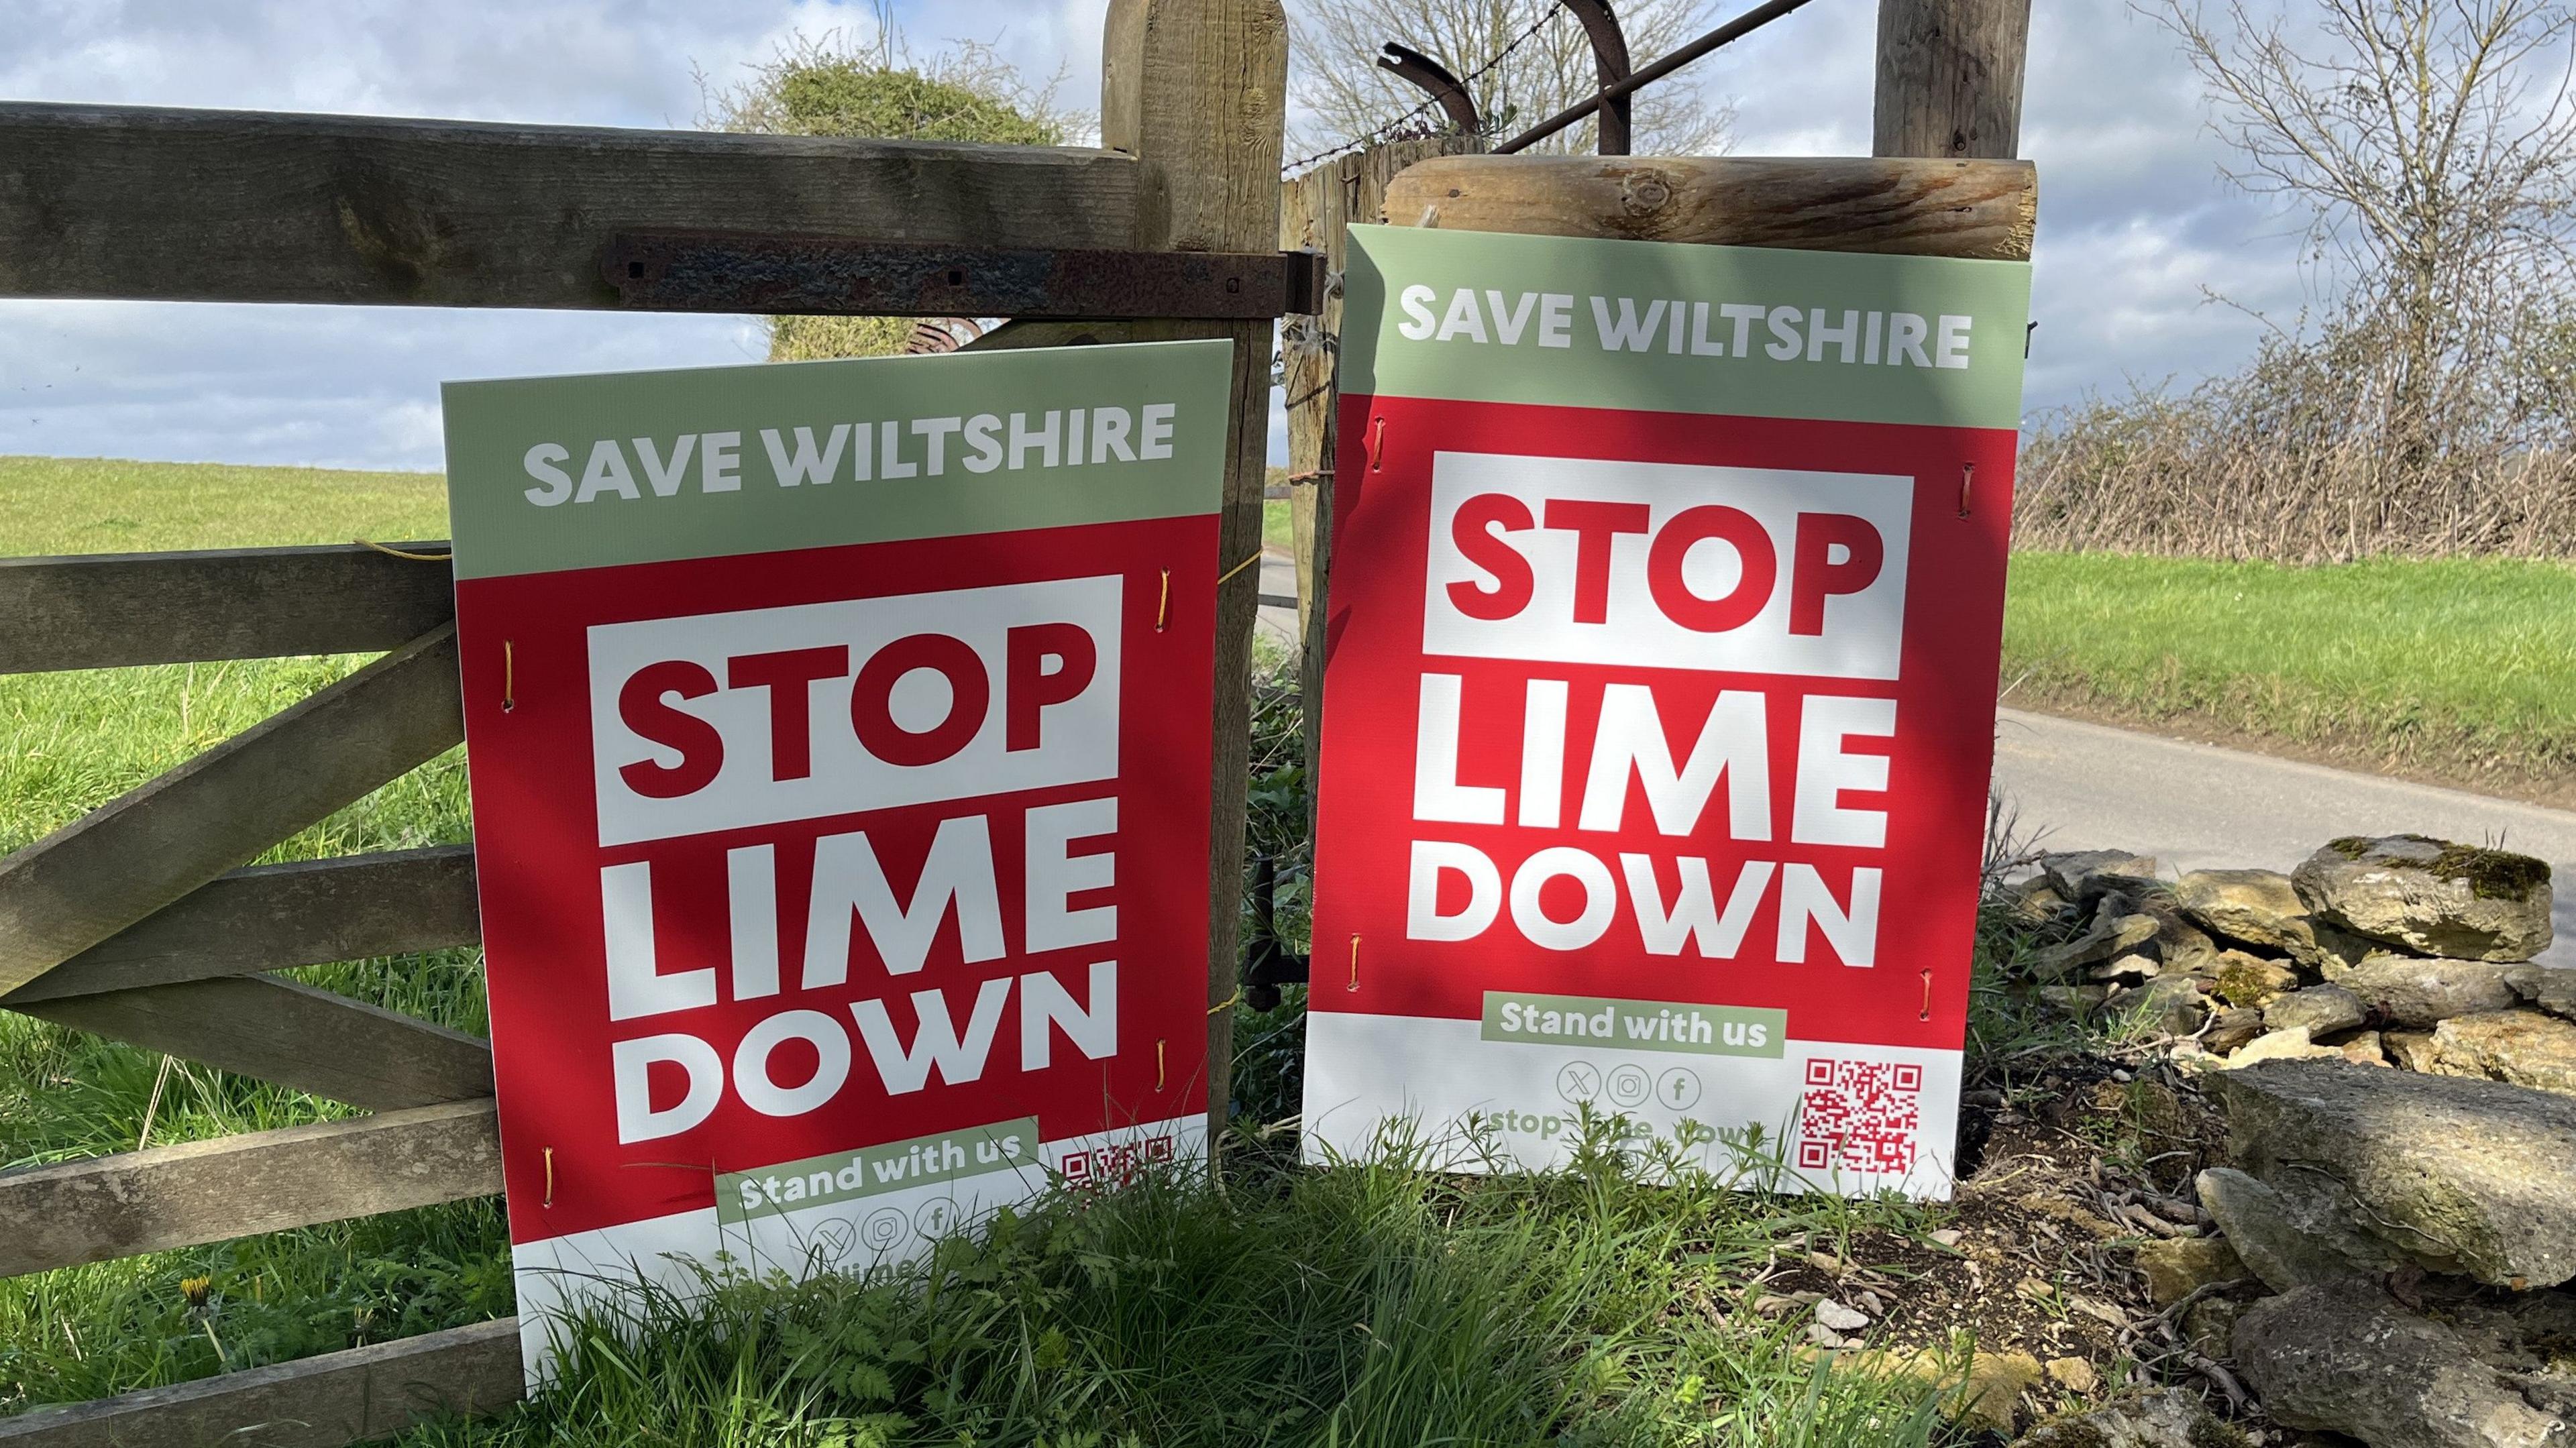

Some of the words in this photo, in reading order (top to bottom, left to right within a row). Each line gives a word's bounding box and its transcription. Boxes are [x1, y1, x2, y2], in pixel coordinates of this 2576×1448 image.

[1397, 283, 1574, 348] SAVE
[1589, 296, 1973, 370] WILTSHIRE
[523, 431, 741, 507] SAVE
[759, 403, 1176, 487] WILTSHIRE
[1446, 492, 1884, 637] STOP
[620, 622, 1097, 798] STOP
[1412, 673, 1897, 848] LIME
[600, 796, 1118, 1021] LIME
[1406, 840, 1882, 968] DOWN
[612, 960, 1118, 1145] DOWN
[1500, 1002, 1615, 1038] Stand
[1623, 1009, 1713, 1044] with
[1723, 1022, 1768, 1048] us
[739, 1156, 863, 1210] Stand
[871, 1139, 966, 1183] with
[976, 1135, 1021, 1164] us
